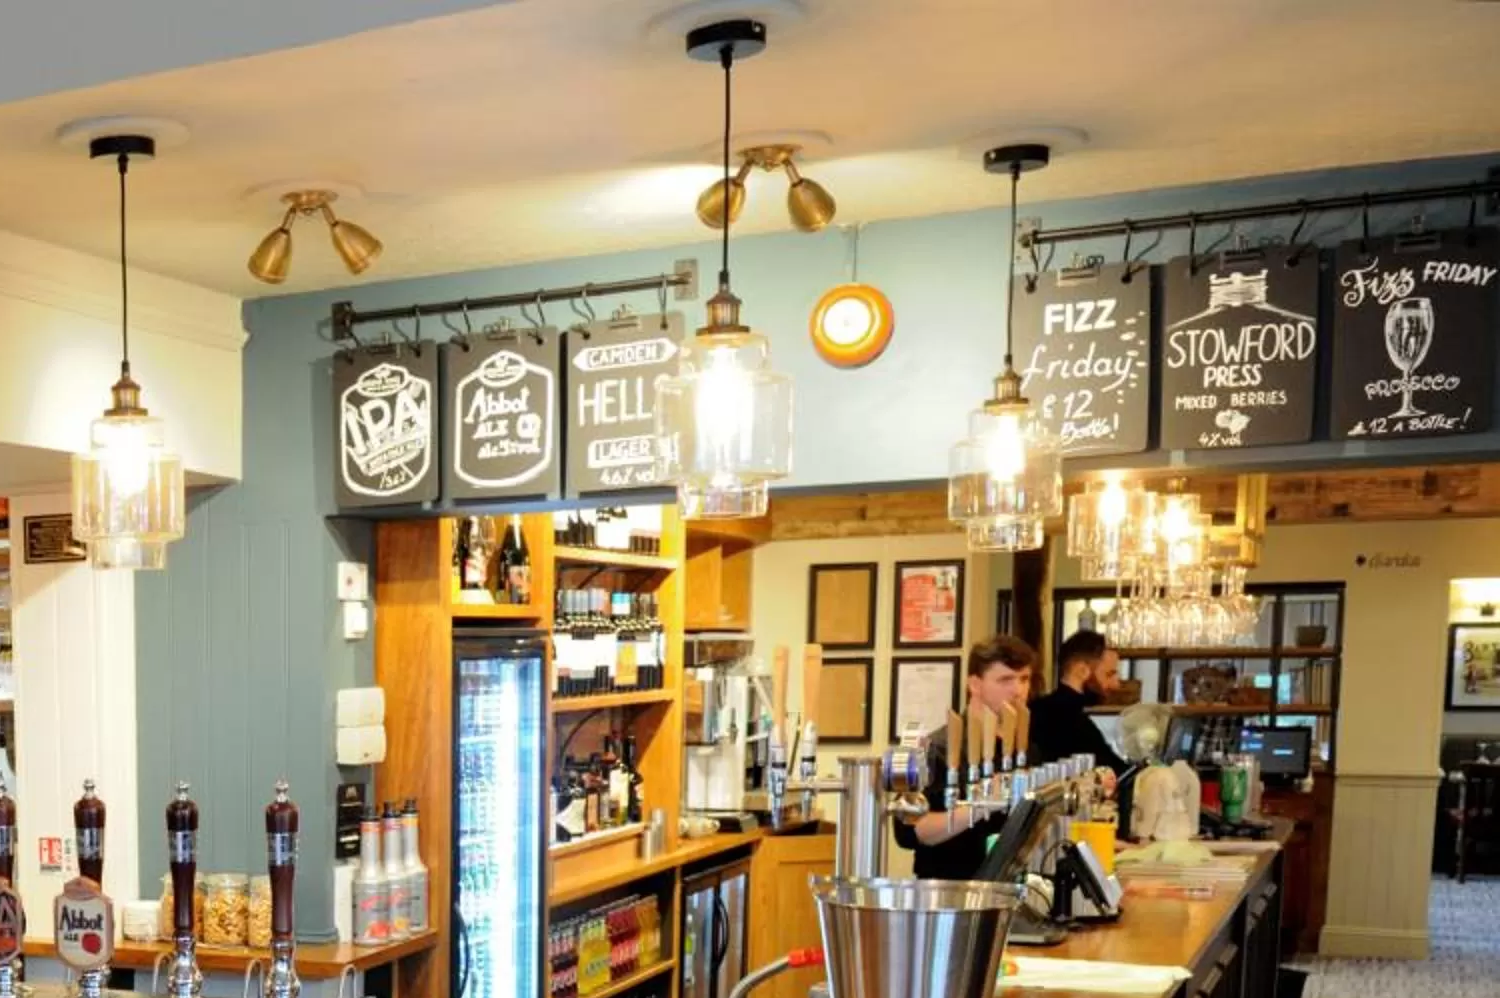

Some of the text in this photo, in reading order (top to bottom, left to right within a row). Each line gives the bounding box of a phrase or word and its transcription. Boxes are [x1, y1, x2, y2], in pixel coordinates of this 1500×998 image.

[1423, 261, 1498, 286] FRIDAY
[1043, 298, 1117, 335] FIZZ
[589, 341, 658, 368] CAMDEN
[1167, 321, 1316, 368] STOWFORD
[1020, 341, 1133, 393] friday
[1203, 363, 1262, 388] PRESS
[464, 385, 531, 423] Abbot
[578, 376, 657, 427] HELL
[1175, 389, 1288, 411] MIXED BERRIES
[345, 389, 426, 457] IPA
[598, 440, 651, 461] LAGER
[60, 903, 103, 932] Abbot
